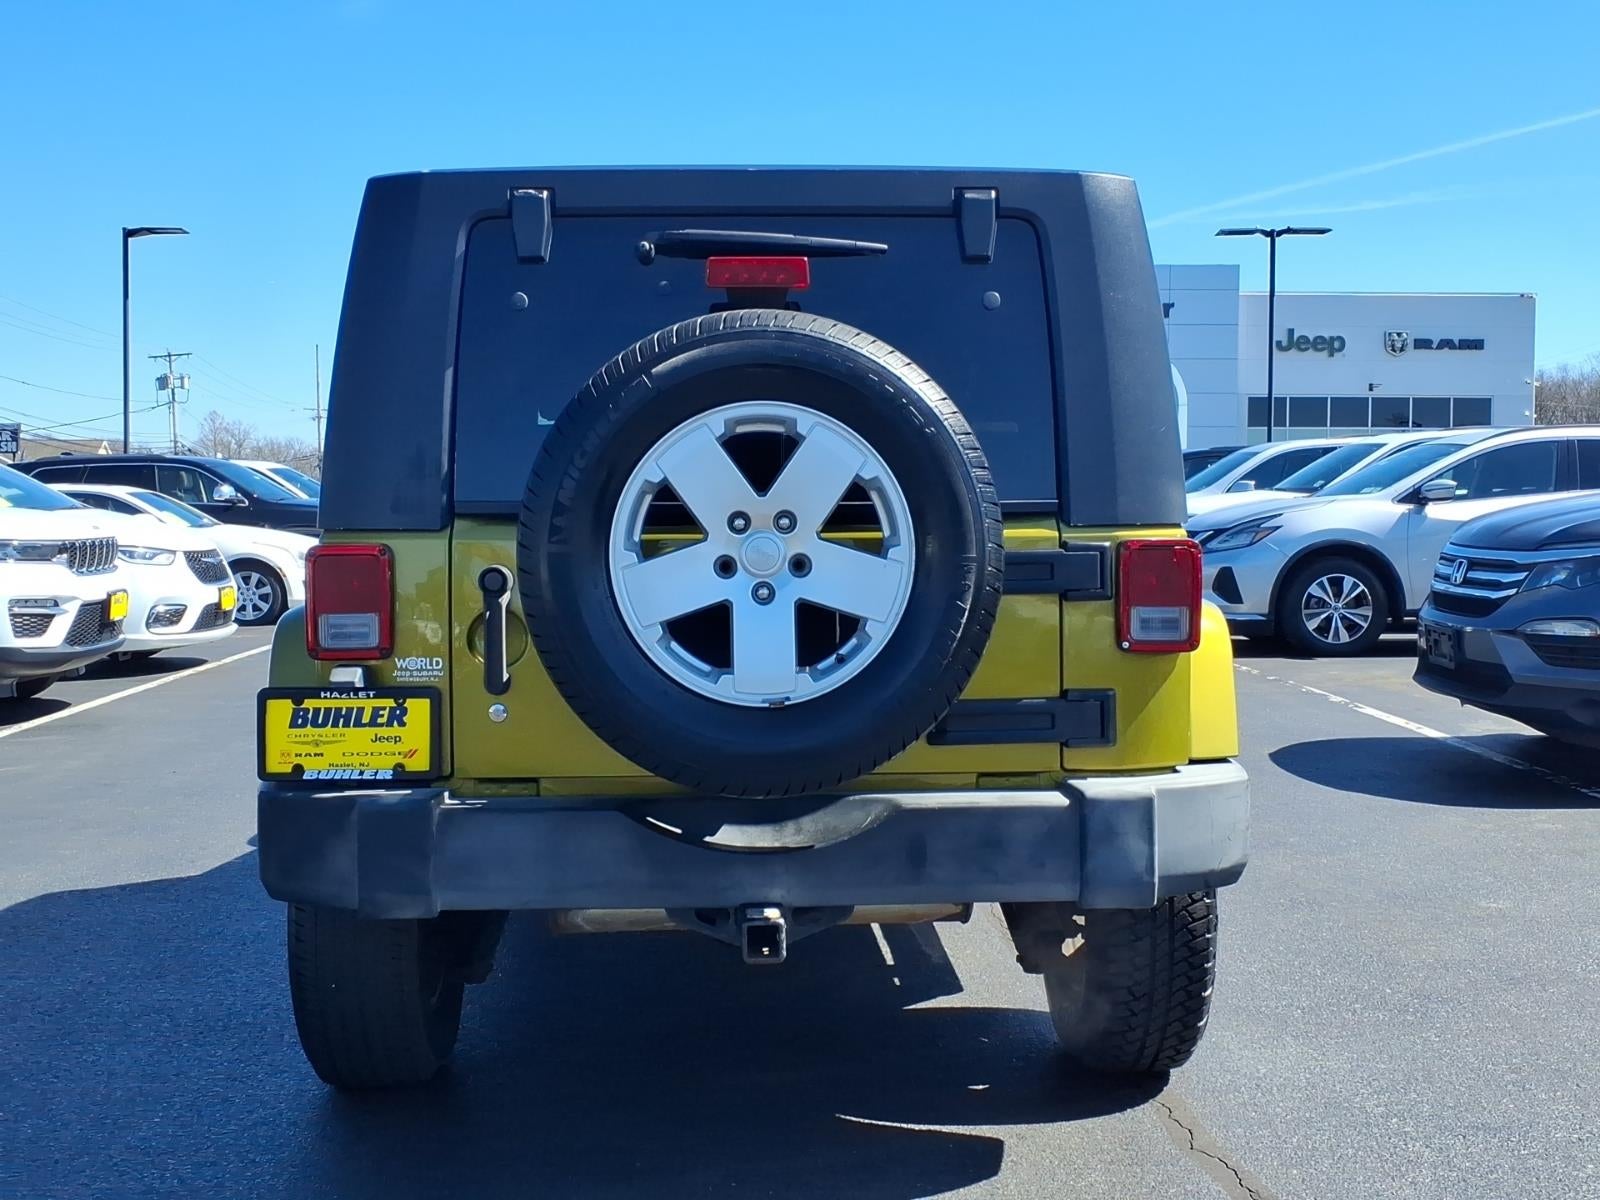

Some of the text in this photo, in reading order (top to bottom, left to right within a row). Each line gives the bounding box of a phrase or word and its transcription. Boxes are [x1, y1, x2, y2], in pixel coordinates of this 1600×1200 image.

[1275, 328, 1346, 357] Jeep
[1413, 338, 1485, 350] RAM
[288, 706, 408, 729] BUHLER
[370, 733, 402, 744] Jeep
[303, 769, 393, 779] BUHLER
